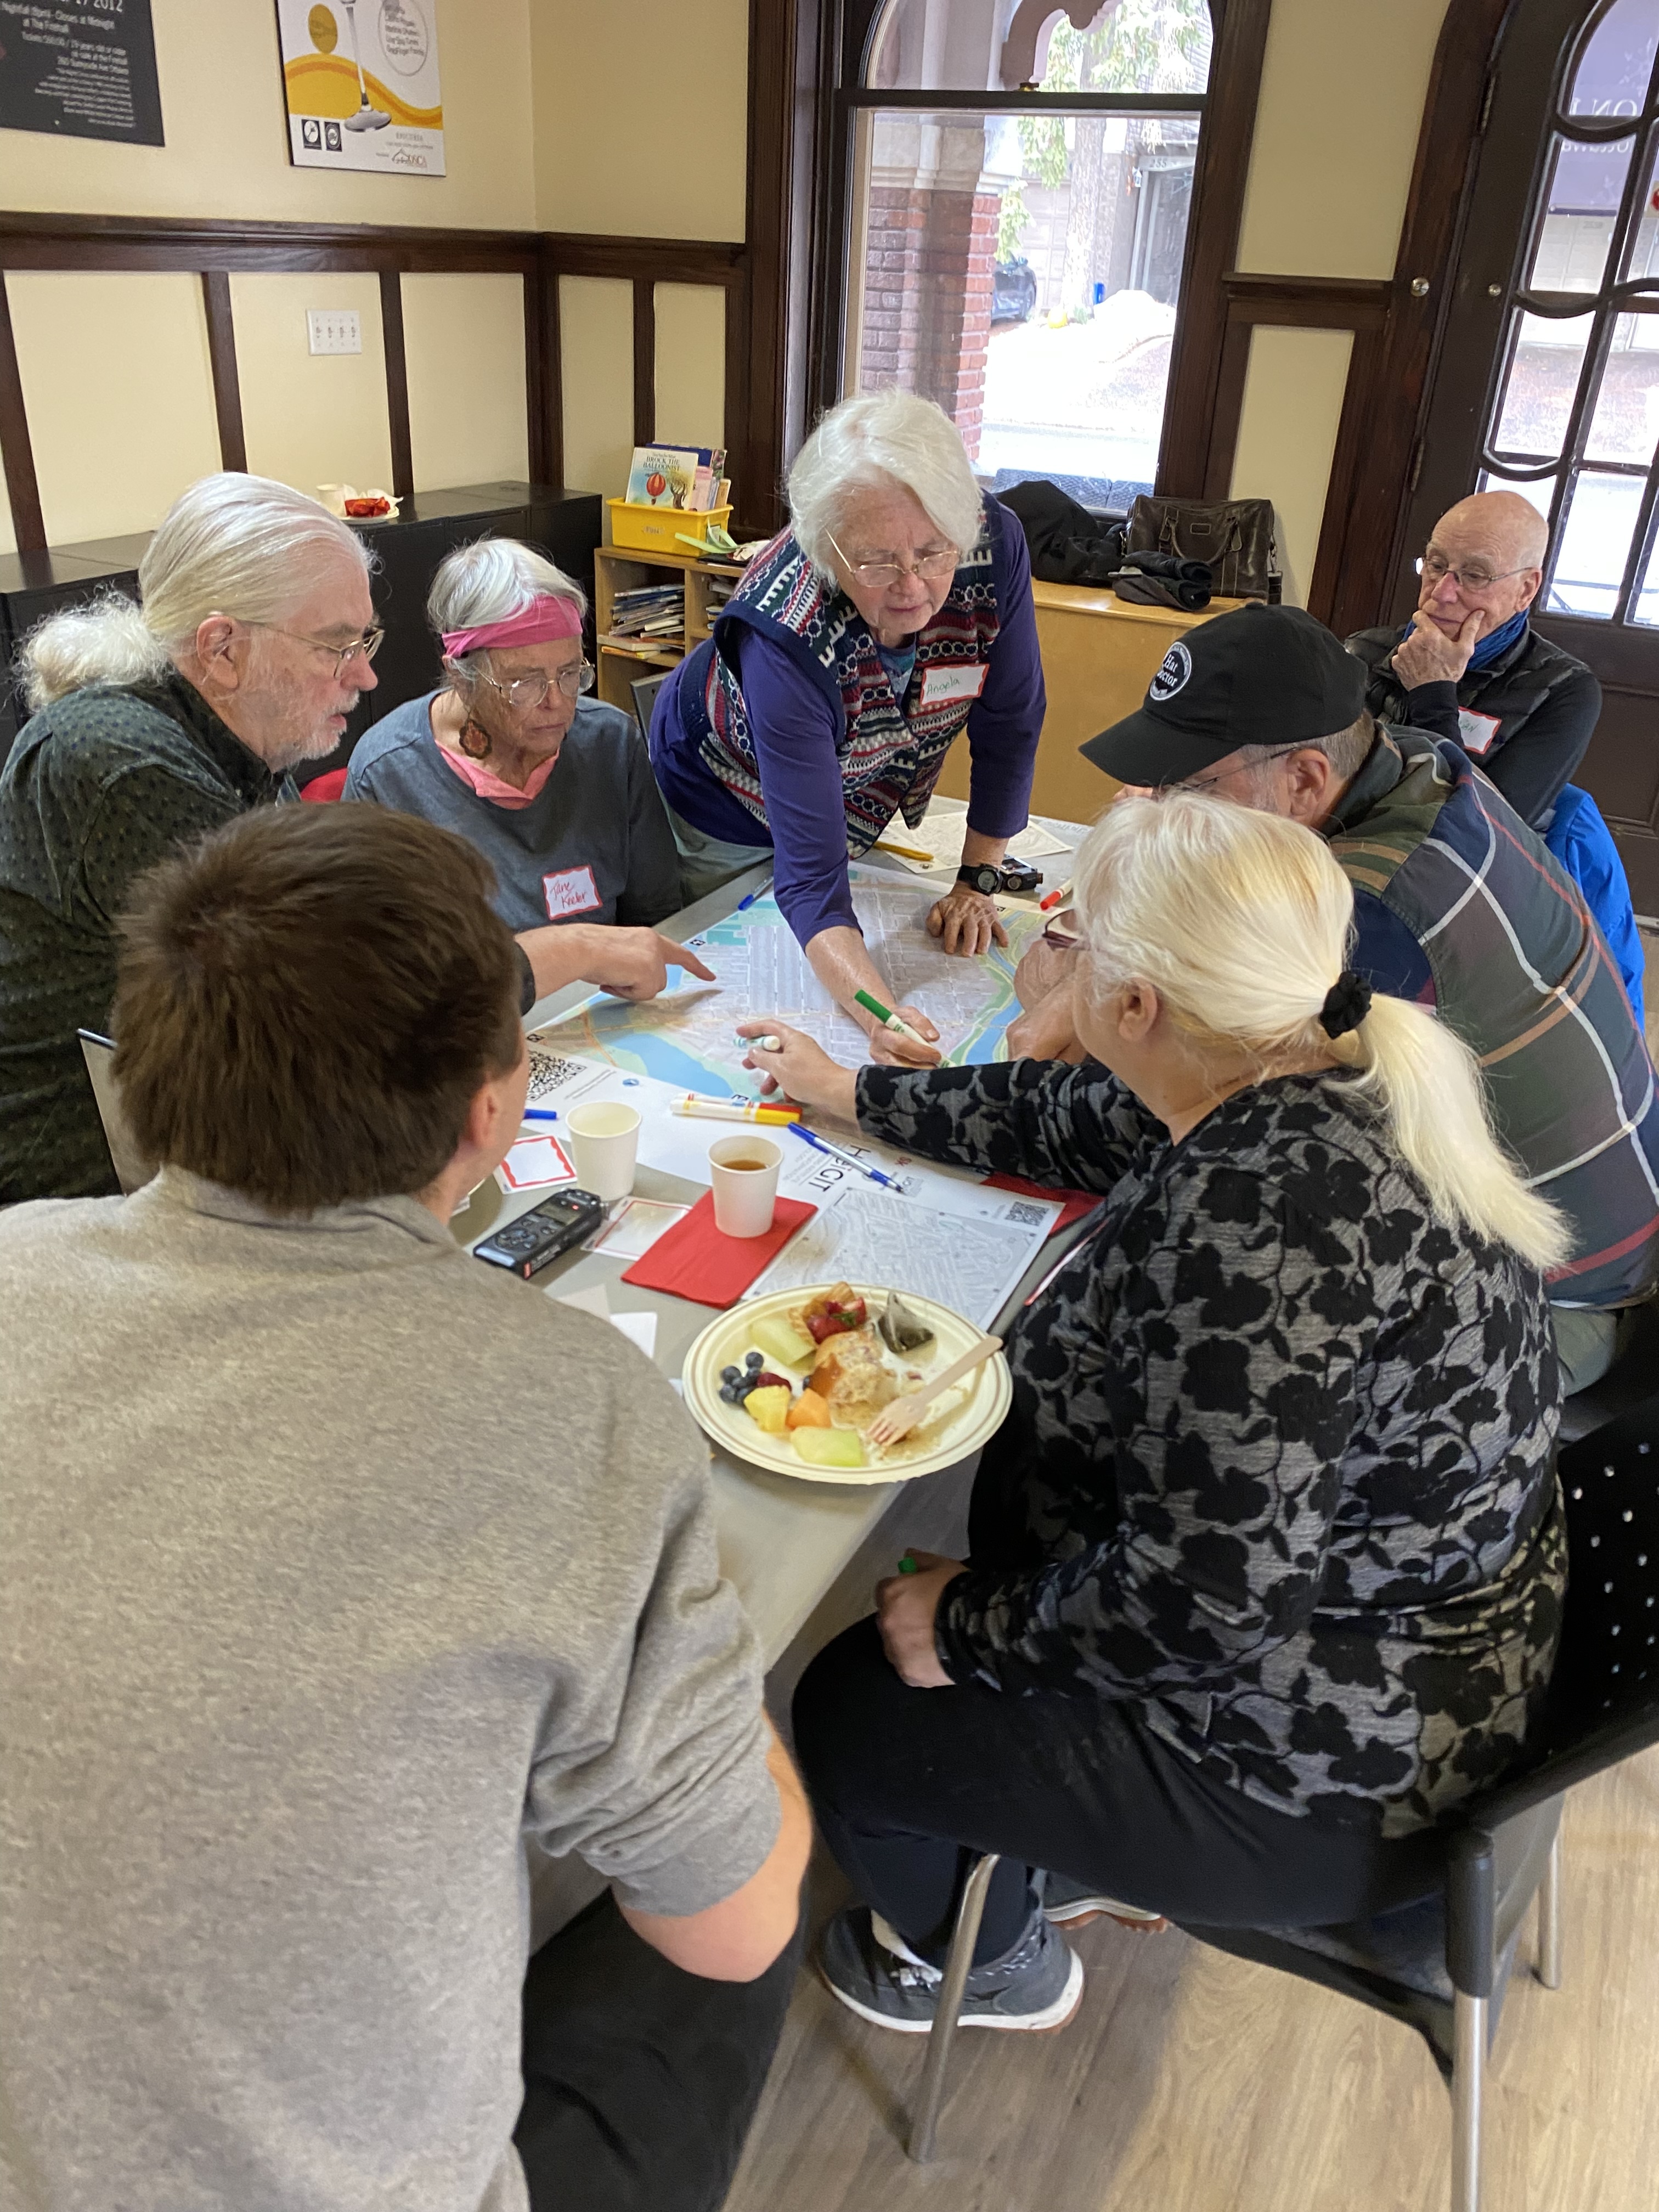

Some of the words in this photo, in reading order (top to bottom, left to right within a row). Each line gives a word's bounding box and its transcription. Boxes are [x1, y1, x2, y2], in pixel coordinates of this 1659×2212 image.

[643, 462, 680, 471] BALLOONIST
[1164, 653, 1178, 673] Hat
[926, 675, 960, 696] Angela
[1157, 669, 1178, 687] octor
